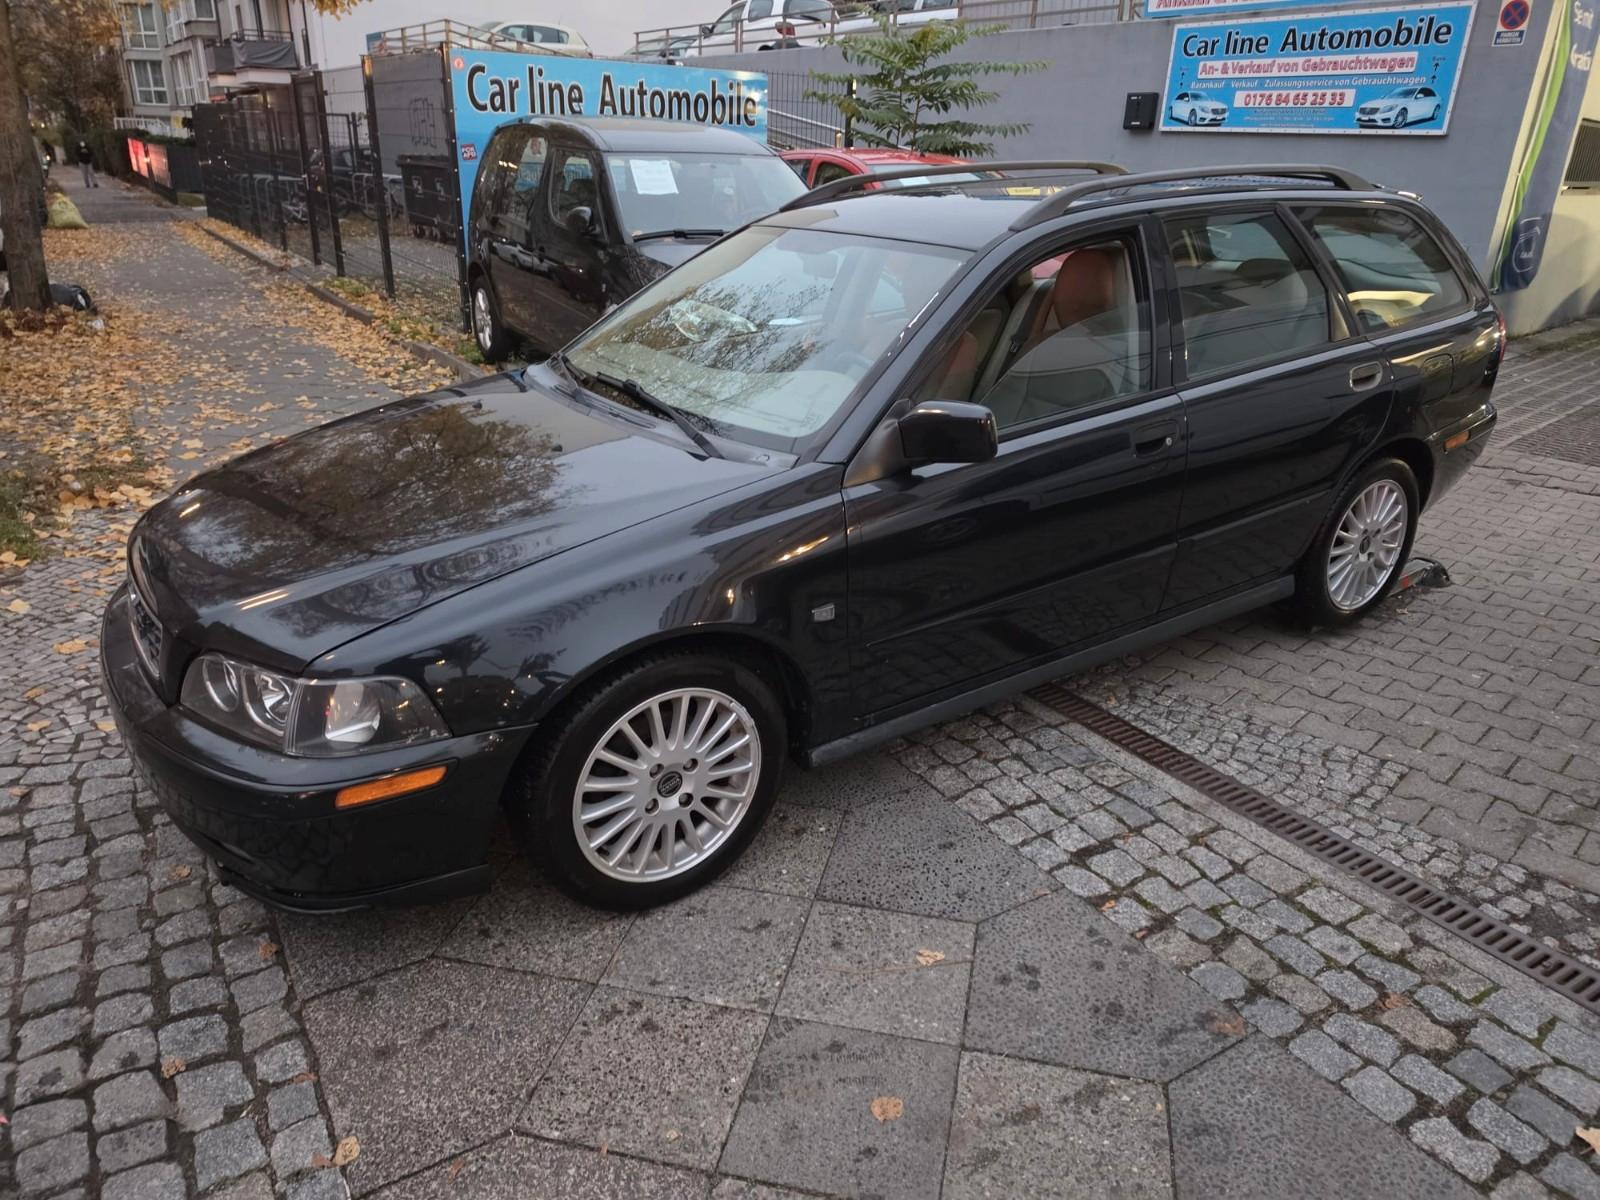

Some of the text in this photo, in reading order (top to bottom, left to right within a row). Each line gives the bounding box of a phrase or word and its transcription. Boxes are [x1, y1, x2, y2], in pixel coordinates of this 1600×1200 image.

[1182, 16, 1452, 57] Car line Automobile
[1200, 55, 1416, 75] An- & Verkauf von Gebrauchtwagen
[1231, 79, 1258, 89] Verkauf
[1264, 79, 1332, 89] Zulassungsservice
[1352, 76, 1426, 87] Gebrauchtwagen
[467, 63, 757, 127] Car line Automobile
[1244, 93, 1273, 106] 0176
[1275, 93, 1290, 106] 84
[1292, 92, 1308, 106] 65
